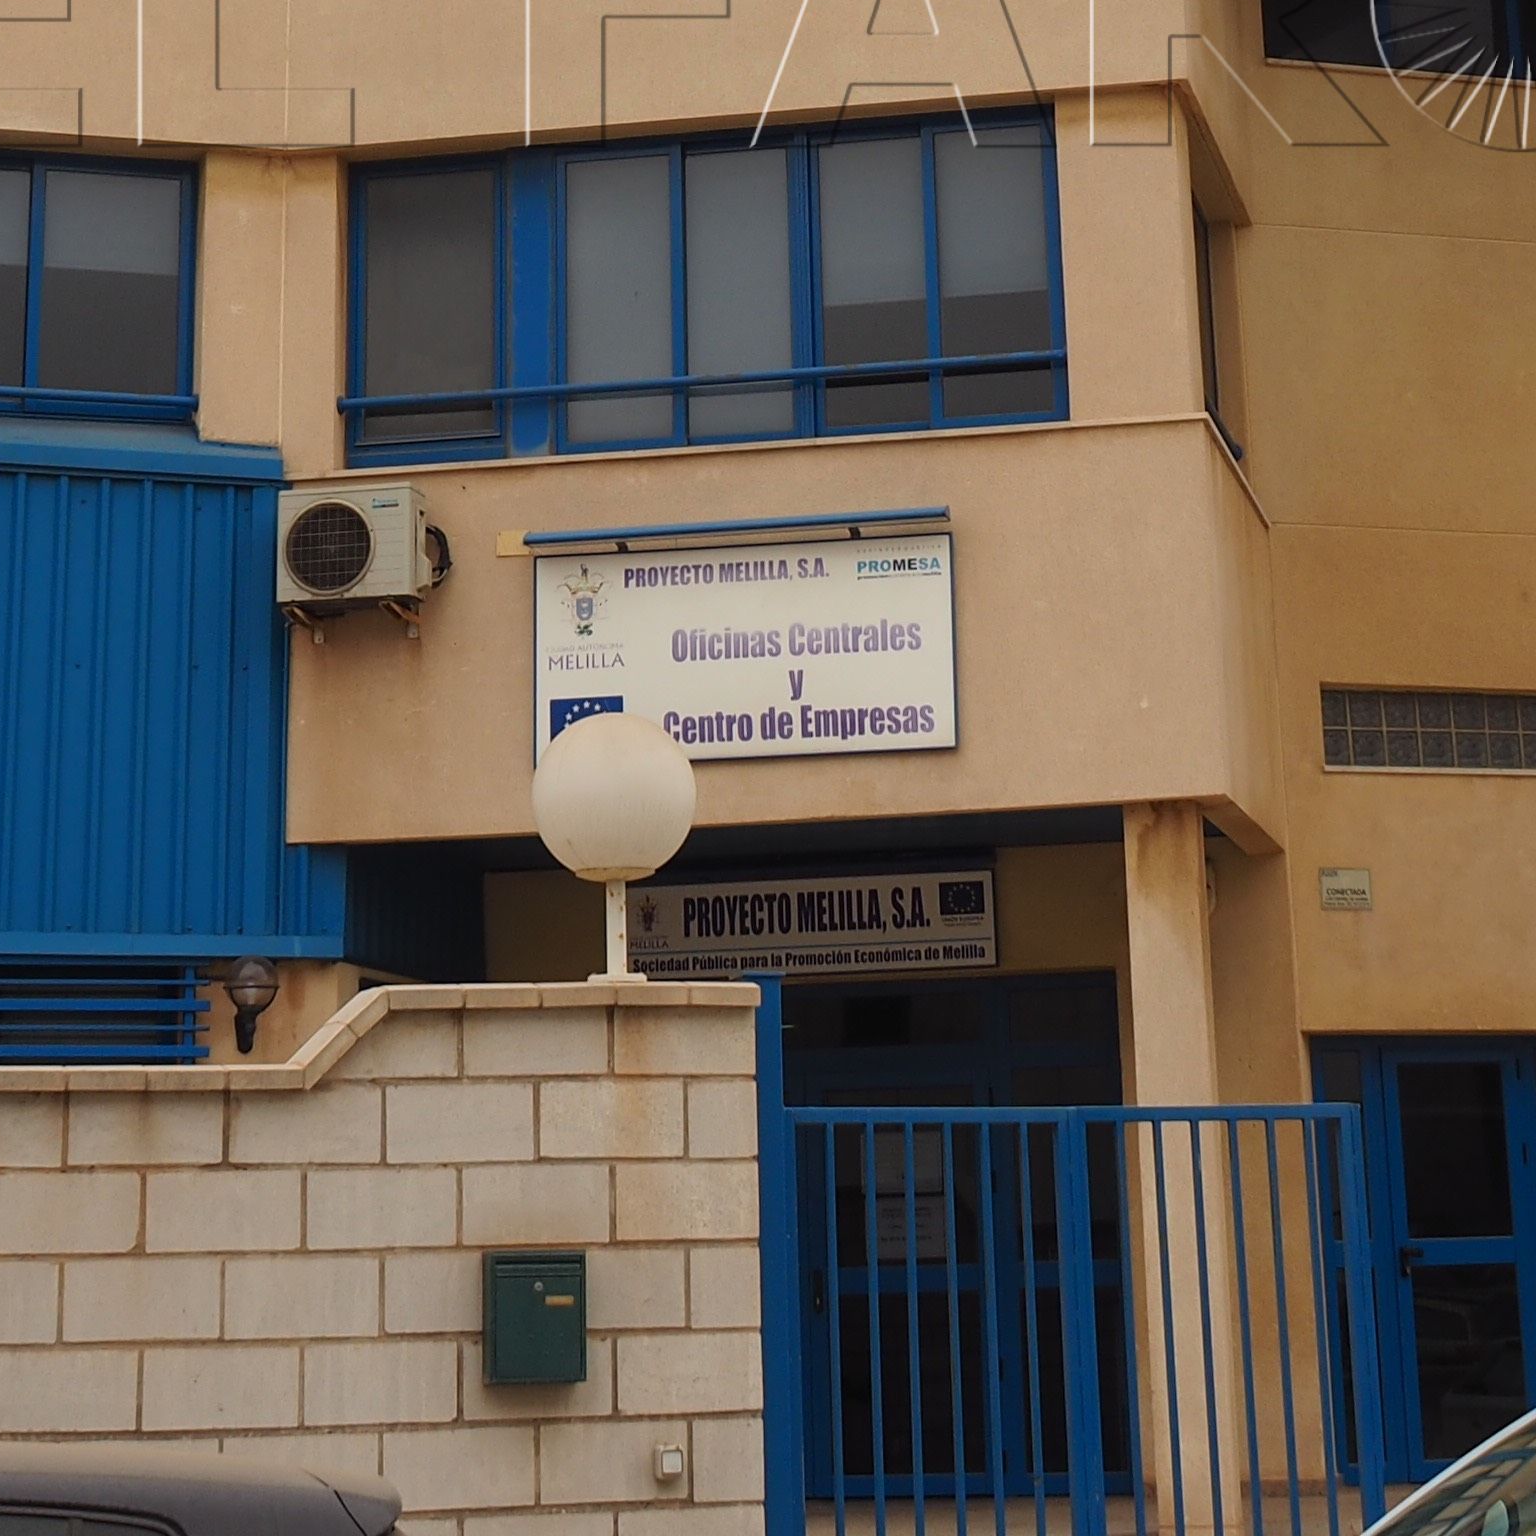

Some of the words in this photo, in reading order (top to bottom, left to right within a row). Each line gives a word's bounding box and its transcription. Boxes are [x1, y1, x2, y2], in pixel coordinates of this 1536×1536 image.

[624, 563, 714, 588] PROYECTO
[719, 559, 793, 583] MELILLA,
[797, 557, 830, 579] S.A.
[857, 557, 941, 573] PROMESA
[672, 627, 782, 662] Oficinas
[788, 619, 922, 657] Centrales
[548, 653, 625, 671] MELILLA
[789, 669, 804, 701] y
[664, 711, 753, 744] Centro
[760, 707, 793, 740] de
[801, 704, 935, 740] Empresas
[683, 893, 791, 937] PROYECTO
[797, 888, 887, 934] MELILLA,
[891, 886, 931, 929] S.A.
[633, 958, 689, 973] Sociedad
[692, 954, 738, 970] Pública
[740, 955, 768, 970] para
[770, 952, 783, 967] la
[785, 949, 852, 967] Promoción
[854, 947, 922, 964] Económica
[924, 946, 940, 960] de
[942, 944, 986, 960] Melilla
